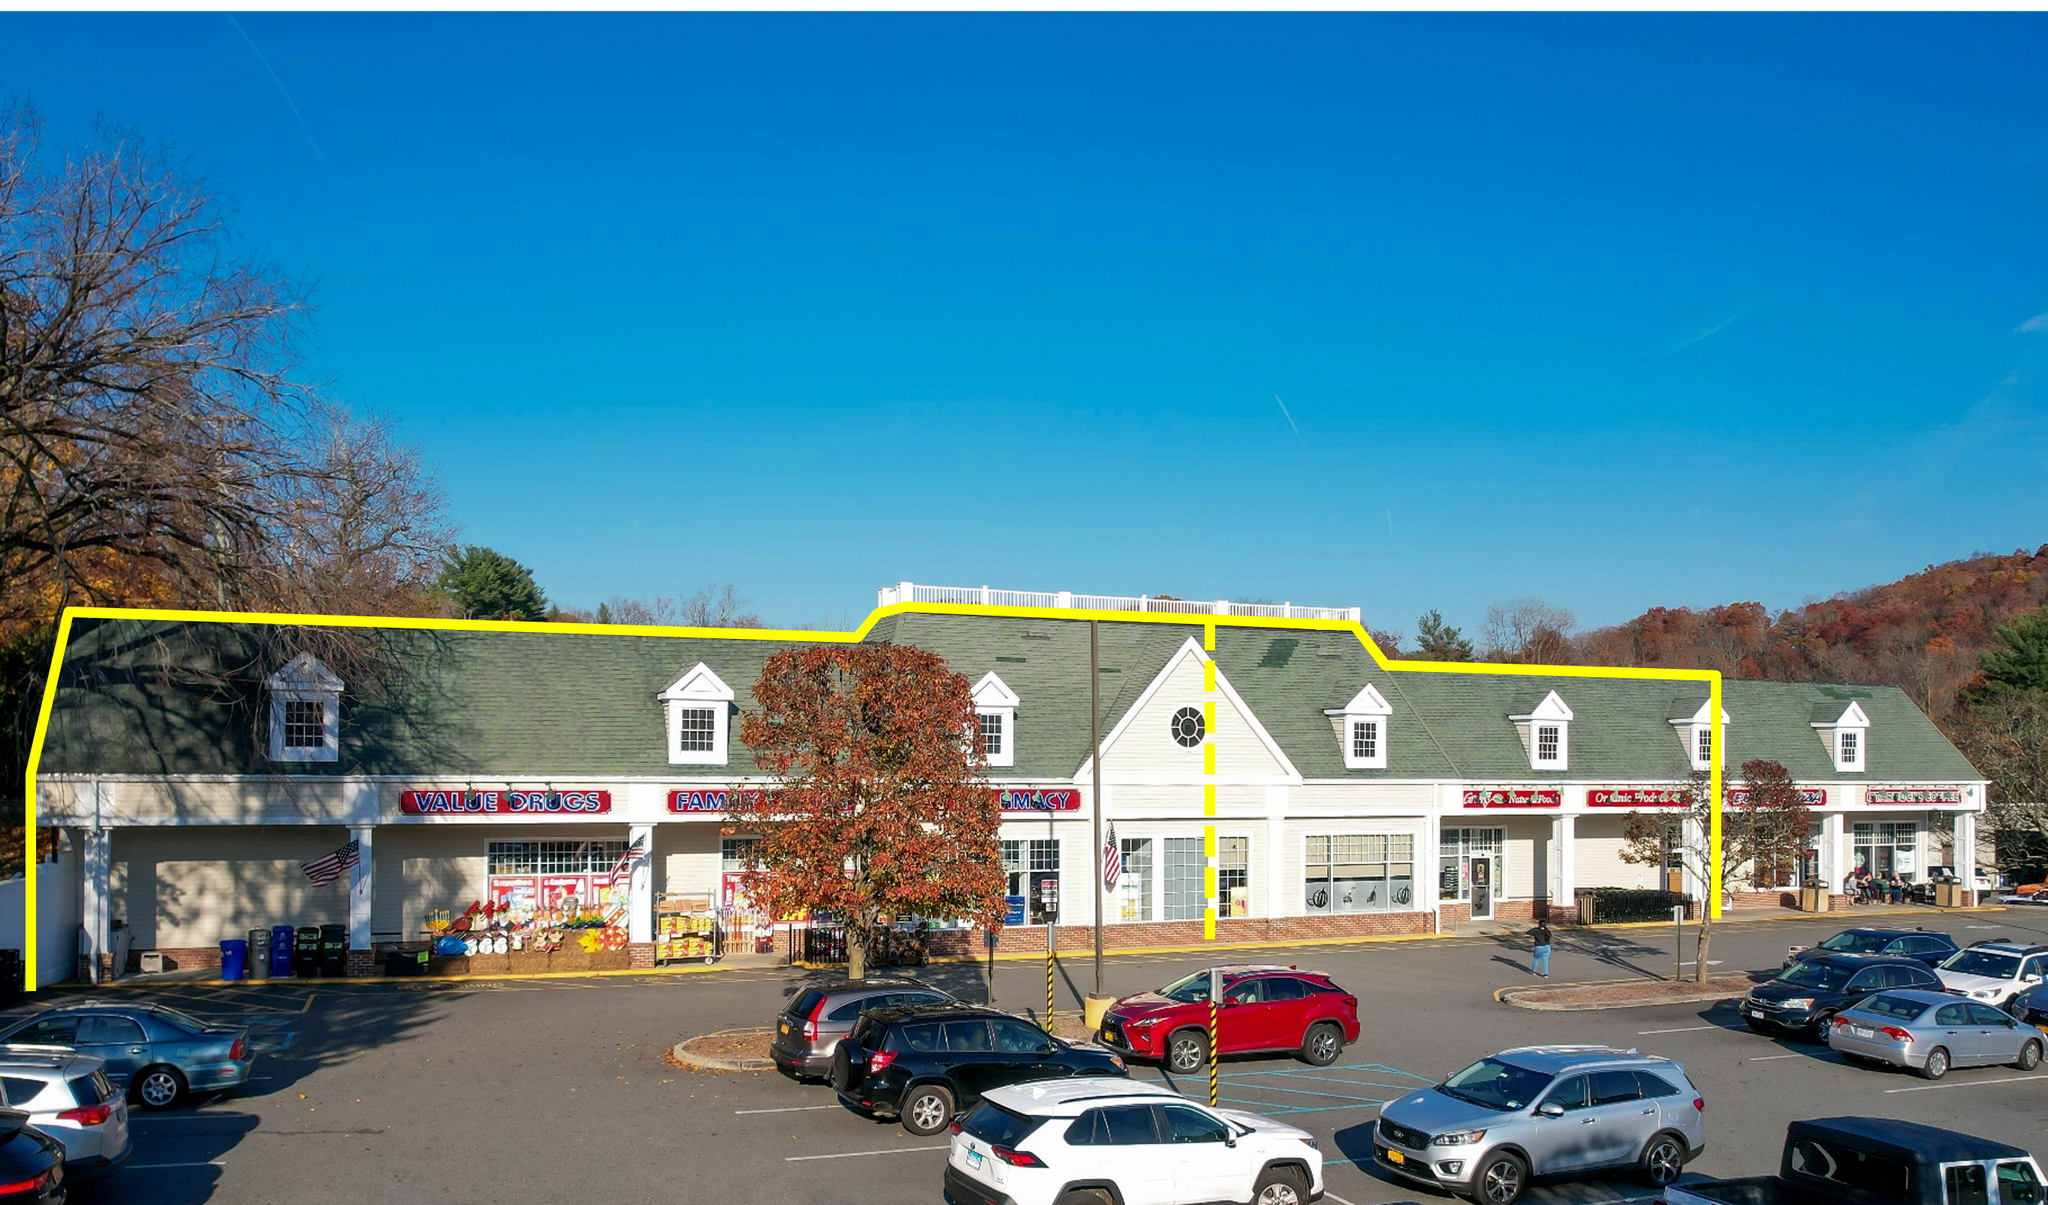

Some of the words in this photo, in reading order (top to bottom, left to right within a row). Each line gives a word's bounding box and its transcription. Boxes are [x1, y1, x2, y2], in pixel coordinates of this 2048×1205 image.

[413, 792, 498, 812] VALUE
[508, 792, 601, 812] DRUGS
[996, 792, 1071, 810] RMACY
[1595, 792, 1633, 805] Oranic
[493, 879, 534, 887] Supplies
